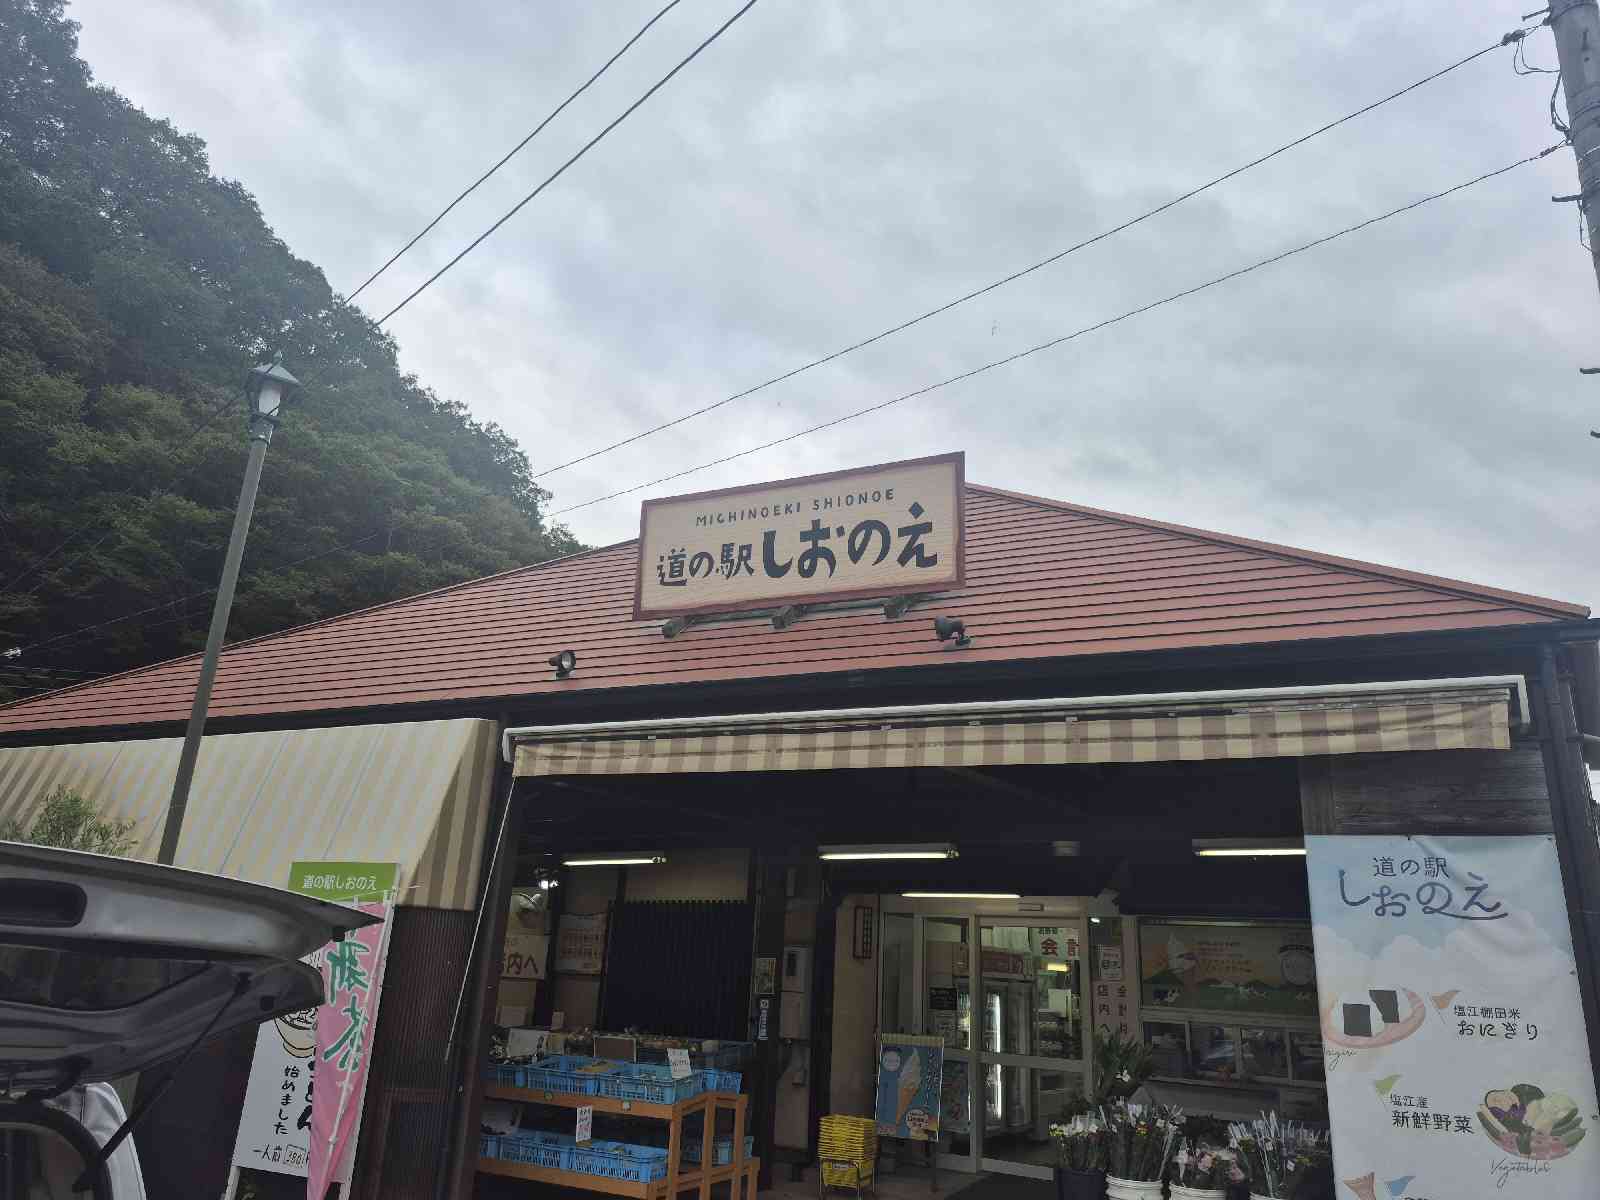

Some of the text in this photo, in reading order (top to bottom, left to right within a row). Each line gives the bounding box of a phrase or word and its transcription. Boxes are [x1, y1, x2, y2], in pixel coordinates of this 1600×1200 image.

[695, 487, 895, 527] MICHINOEKI SHIONOE
[1372, 856, 1451, 878] 道の駅
[303, 873, 377, 891] 道の駅しおのえ
[1338, 869, 1509, 920] しおのえ
[504, 952, 539, 975] 内へ
[1457, 1020, 1539, 1041] おにぎり
[273, 1065, 300, 1135] 始めました
[1392, 1110, 1475, 1135] 新鮮野菜
